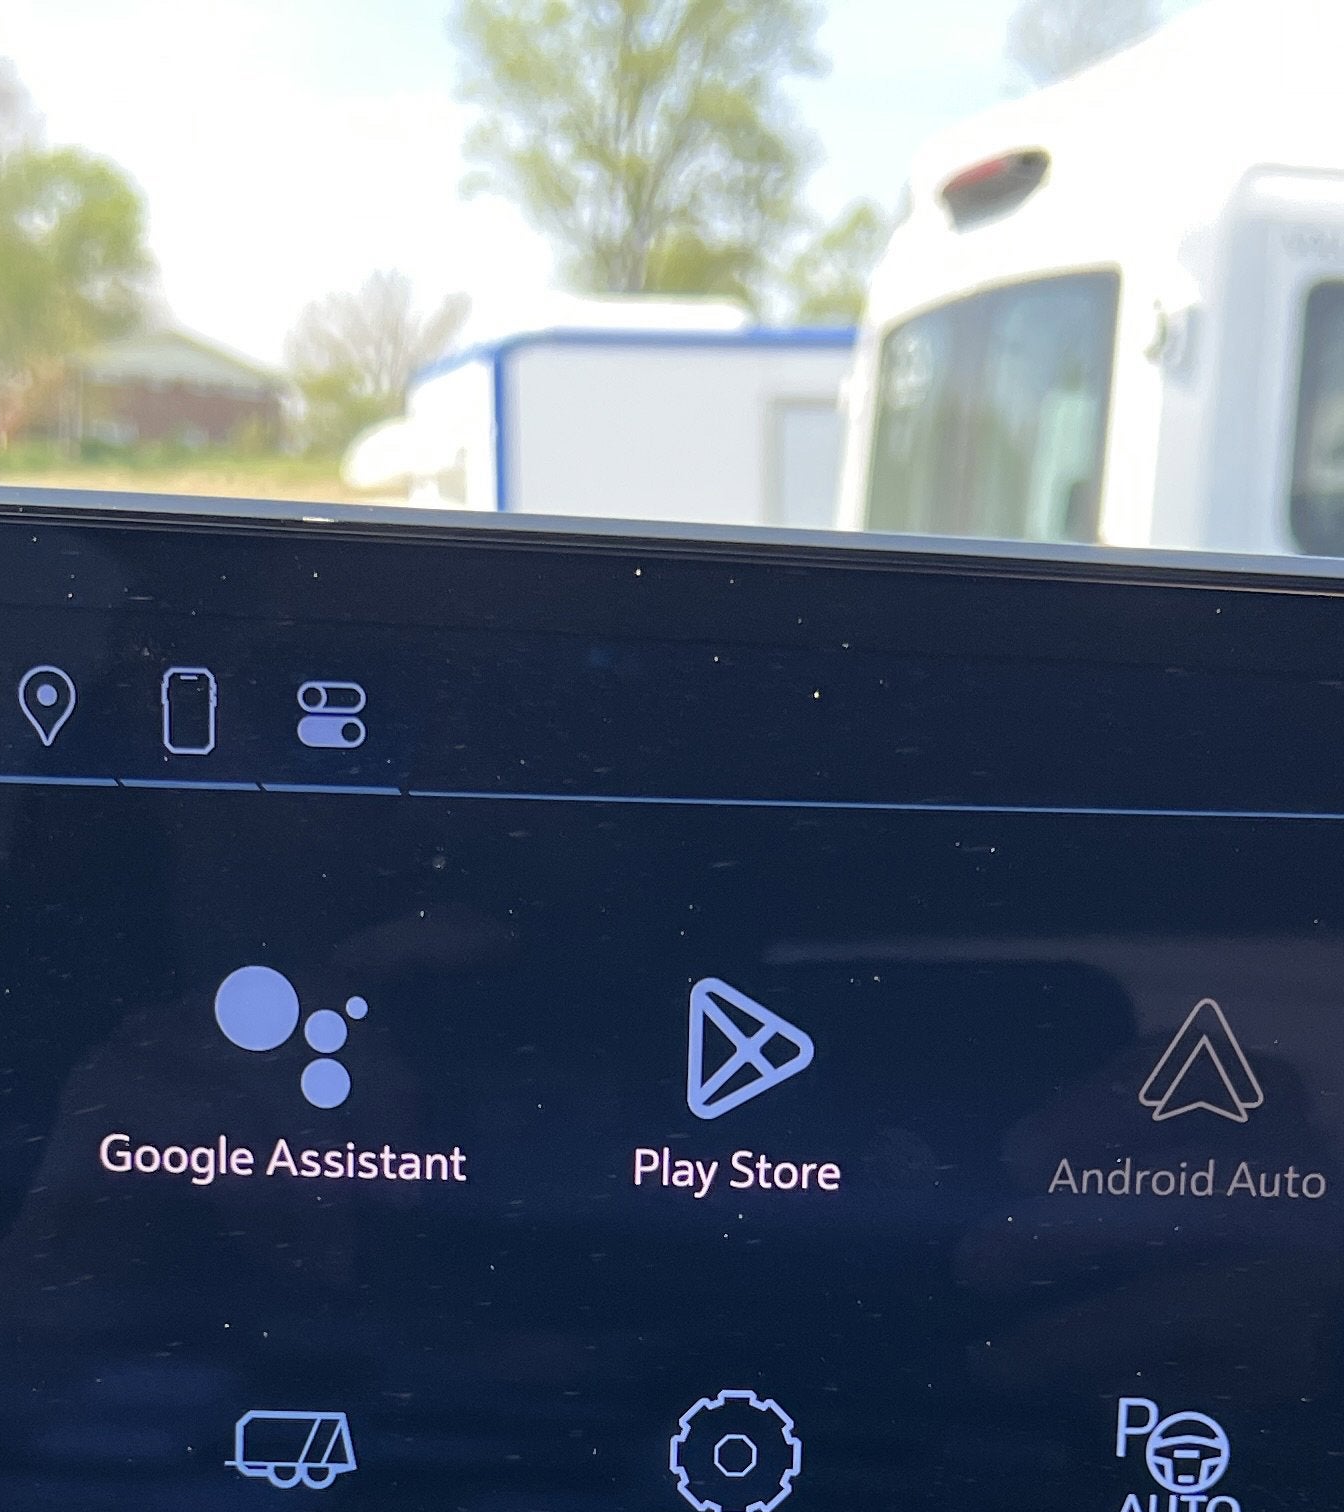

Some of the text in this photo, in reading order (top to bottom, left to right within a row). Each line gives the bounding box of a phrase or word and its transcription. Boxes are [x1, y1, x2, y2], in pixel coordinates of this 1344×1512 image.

[99, 1132, 468, 1187] Google Assistant
[633, 1145, 842, 1200] Play Store
[1047, 1156, 1327, 1200] Android Auto
[1114, 1395, 1158, 1460] P
